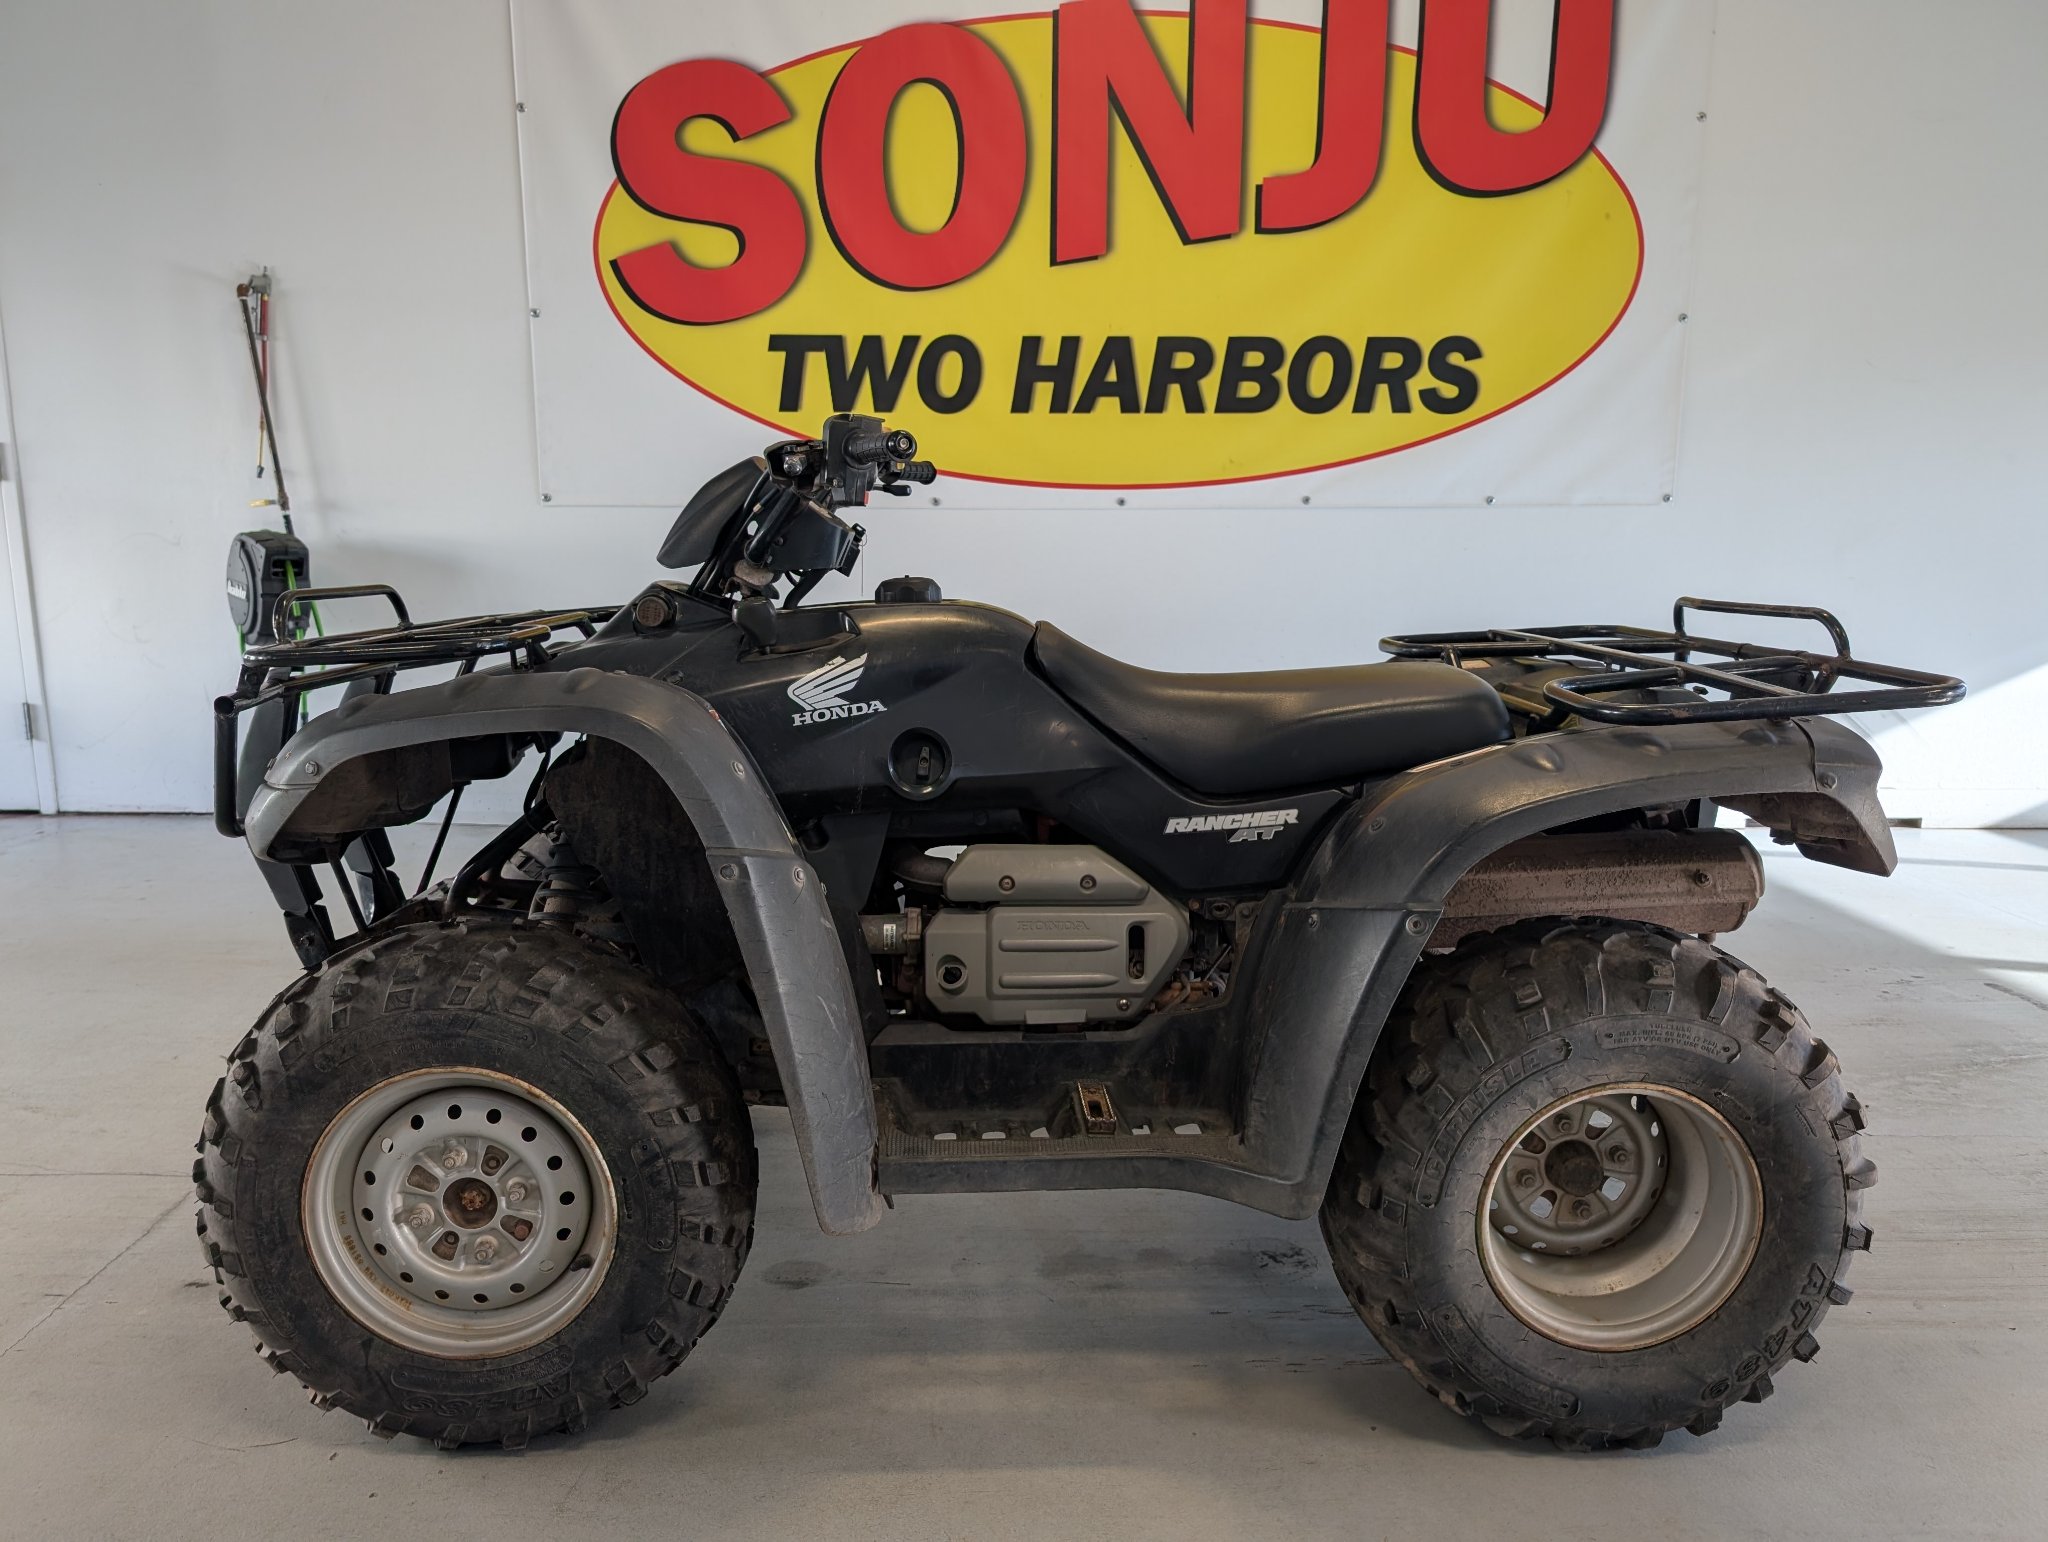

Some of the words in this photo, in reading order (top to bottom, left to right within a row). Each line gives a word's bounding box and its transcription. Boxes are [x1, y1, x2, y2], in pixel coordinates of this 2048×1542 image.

[610, 0, 1615, 325] SONJU
[768, 333, 984, 414] TWO
[1009, 334, 1484, 414] HARBORS
[792, 700, 888, 726] HONDA
[1164, 809, 1299, 834] RANCHER
[1227, 825, 1284, 843] AT
[1016, 920, 1091, 931] HONDA
[1425, 1049, 1543, 1179] CARLISLE
[1701, 1262, 1827, 1401] AT489
